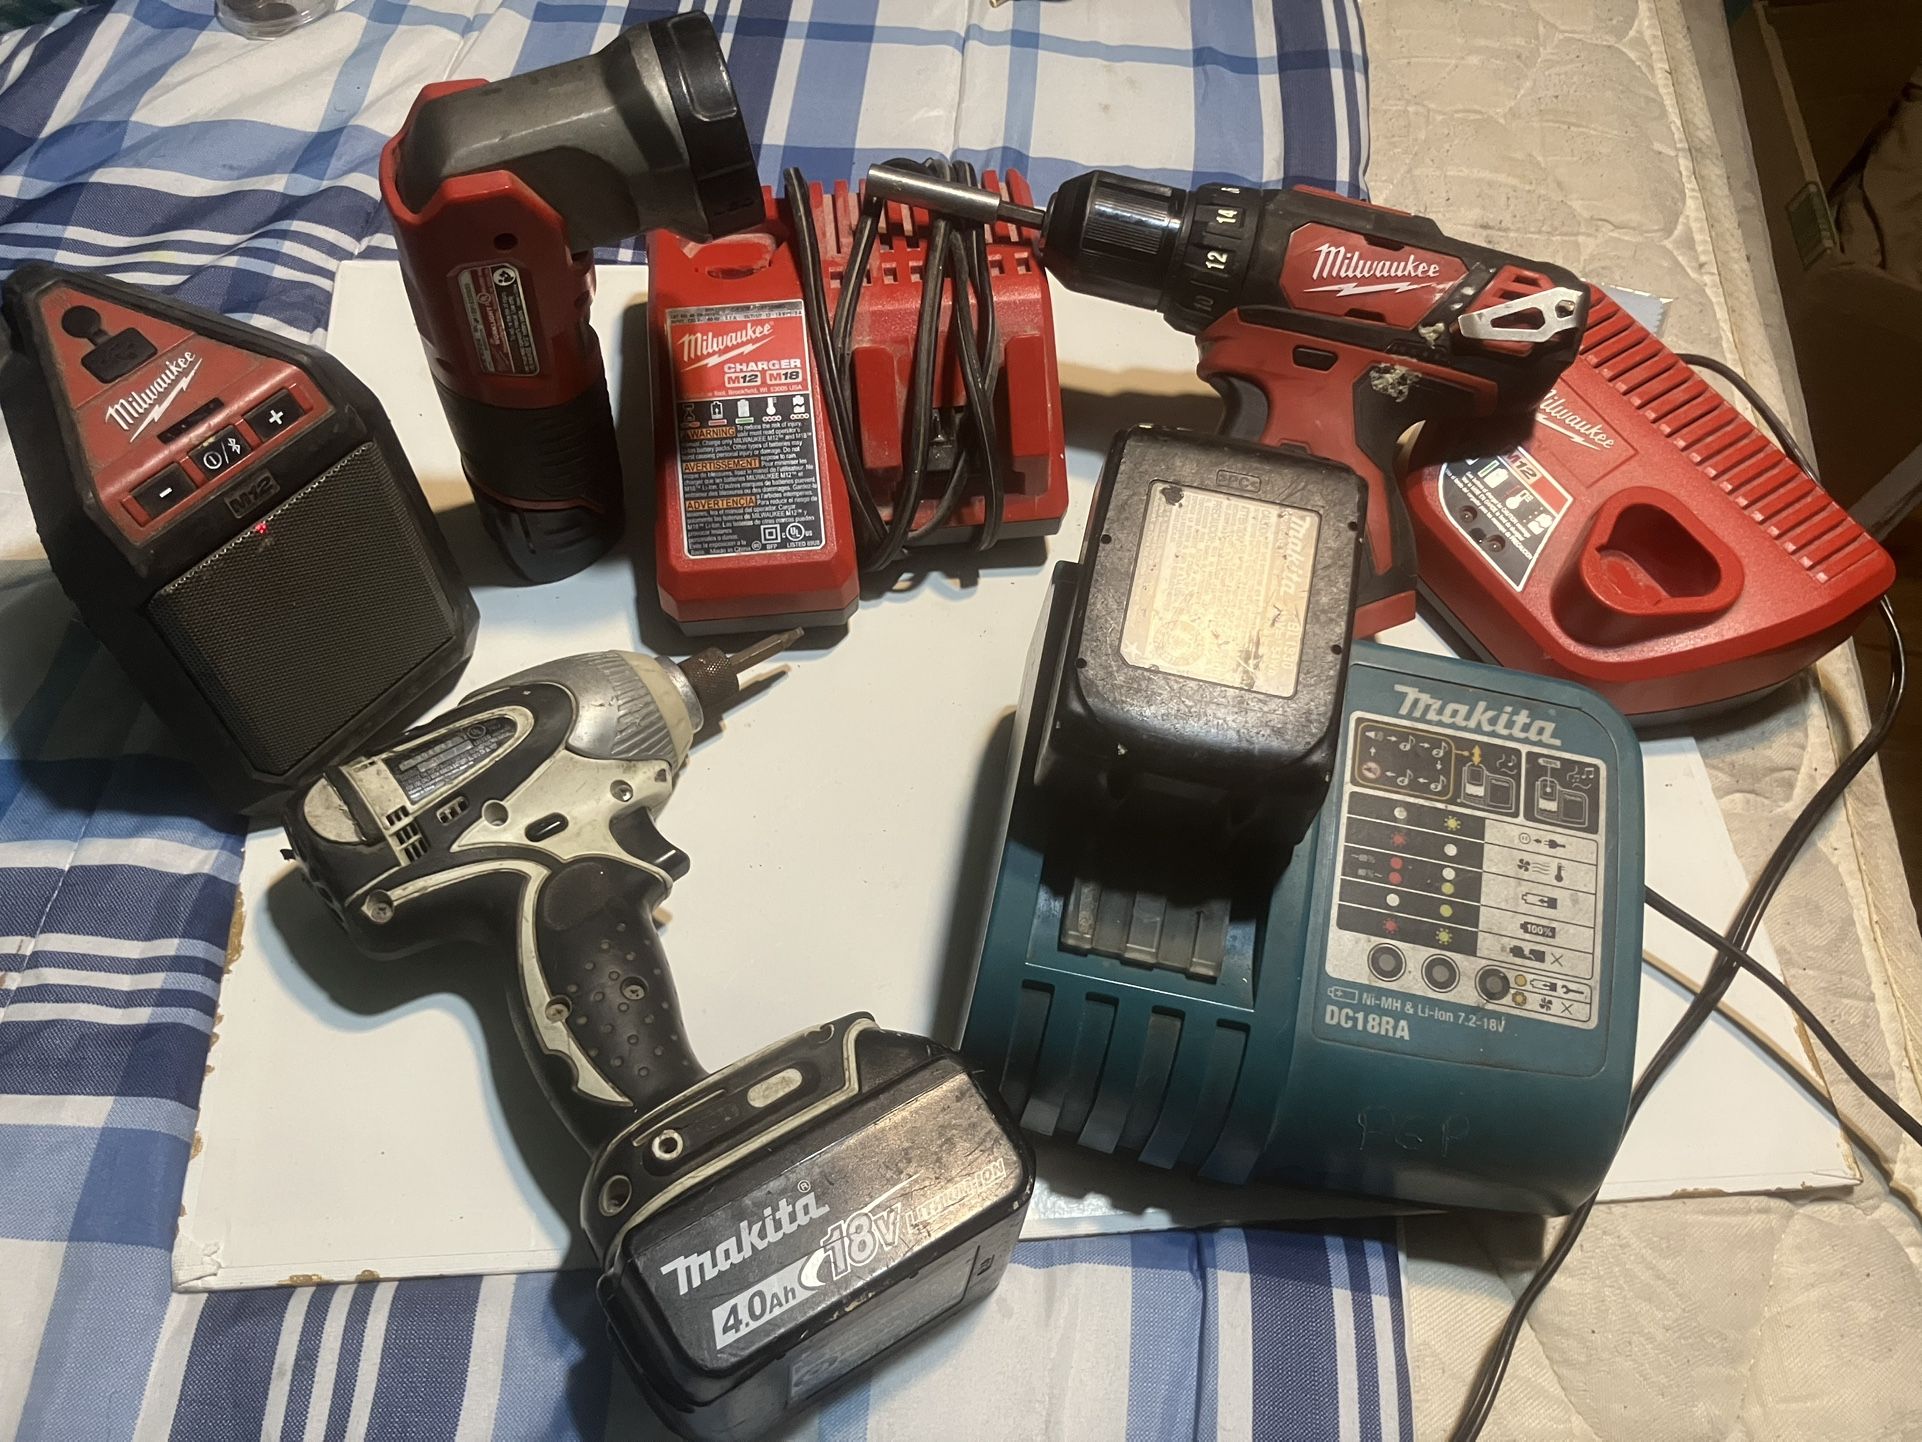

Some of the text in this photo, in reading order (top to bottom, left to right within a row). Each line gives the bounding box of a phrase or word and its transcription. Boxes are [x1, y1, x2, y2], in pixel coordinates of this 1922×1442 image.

[1216, 208, 1238, 224] 14
[1205, 250, 1228, 270] 12
[1312, 243, 1440, 280] Milwaukee
[678, 322, 773, 363] Milwaukee
[723, 357, 801, 373] CHARGER
[726, 369, 800, 385] M12 M18
[105, 349, 197, 433] Milwaukee
[690, 427, 735, 439] WARNING
[684, 457, 759, 473] AVERTISSEMENT
[687, 496, 753, 511] ADVERTENCIA
[1394, 685, 1562, 747] Makita
[1526, 923, 1553, 937] 100%
[1324, 1004, 1411, 1041] DC18RA
[1361, 992, 1507, 1033] Ni-MH & Li-Ion 7.2-18V
[660, 1191, 831, 1296] Makita
[721, 1286, 797, 1335] 4.0Ah
[820, 1201, 902, 1281] 18V
